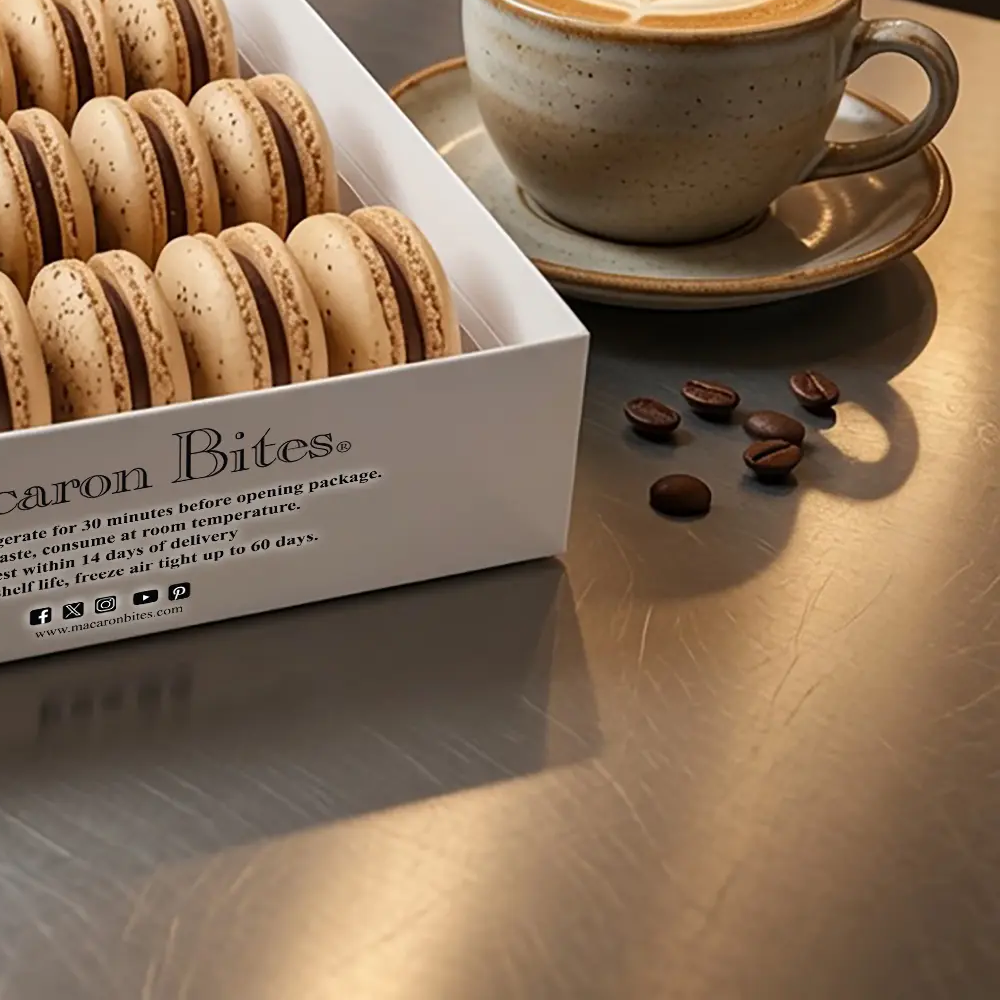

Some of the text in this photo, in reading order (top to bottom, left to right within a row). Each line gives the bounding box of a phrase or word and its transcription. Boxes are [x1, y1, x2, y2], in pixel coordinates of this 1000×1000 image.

[42, 534, 116, 556] consume
[120, 531, 137, 542] at
[142, 521, 186, 538] room
[191, 501, 301, 528] temperature.
[53, 523, 77, 537] for
[82, 517, 101, 532] 30
[107, 506, 173, 527] minutes
[179, 495, 232, 514] before
[236, 482, 304, 504] opening
[309, 468, 382, 493] package.
[23, 557, 75, 577] within
[82, 552, 100, 566] 14
[105, 546, 144, 561] days
[149, 540, 168, 554] of
[170, 528, 238, 550] delivery
[38, 575, 69, 592] life,
[75, 566, 125, 584] freeze
[129, 561, 154, 575] air
[158, 551, 198, 570] tight
[203, 549, 225, 563] up
[229, 543, 246, 556] to
[251, 538, 270, 552] 60
[275, 531, 319, 549] days.
[35, 605, 183, 639] www.macaronbites.com
